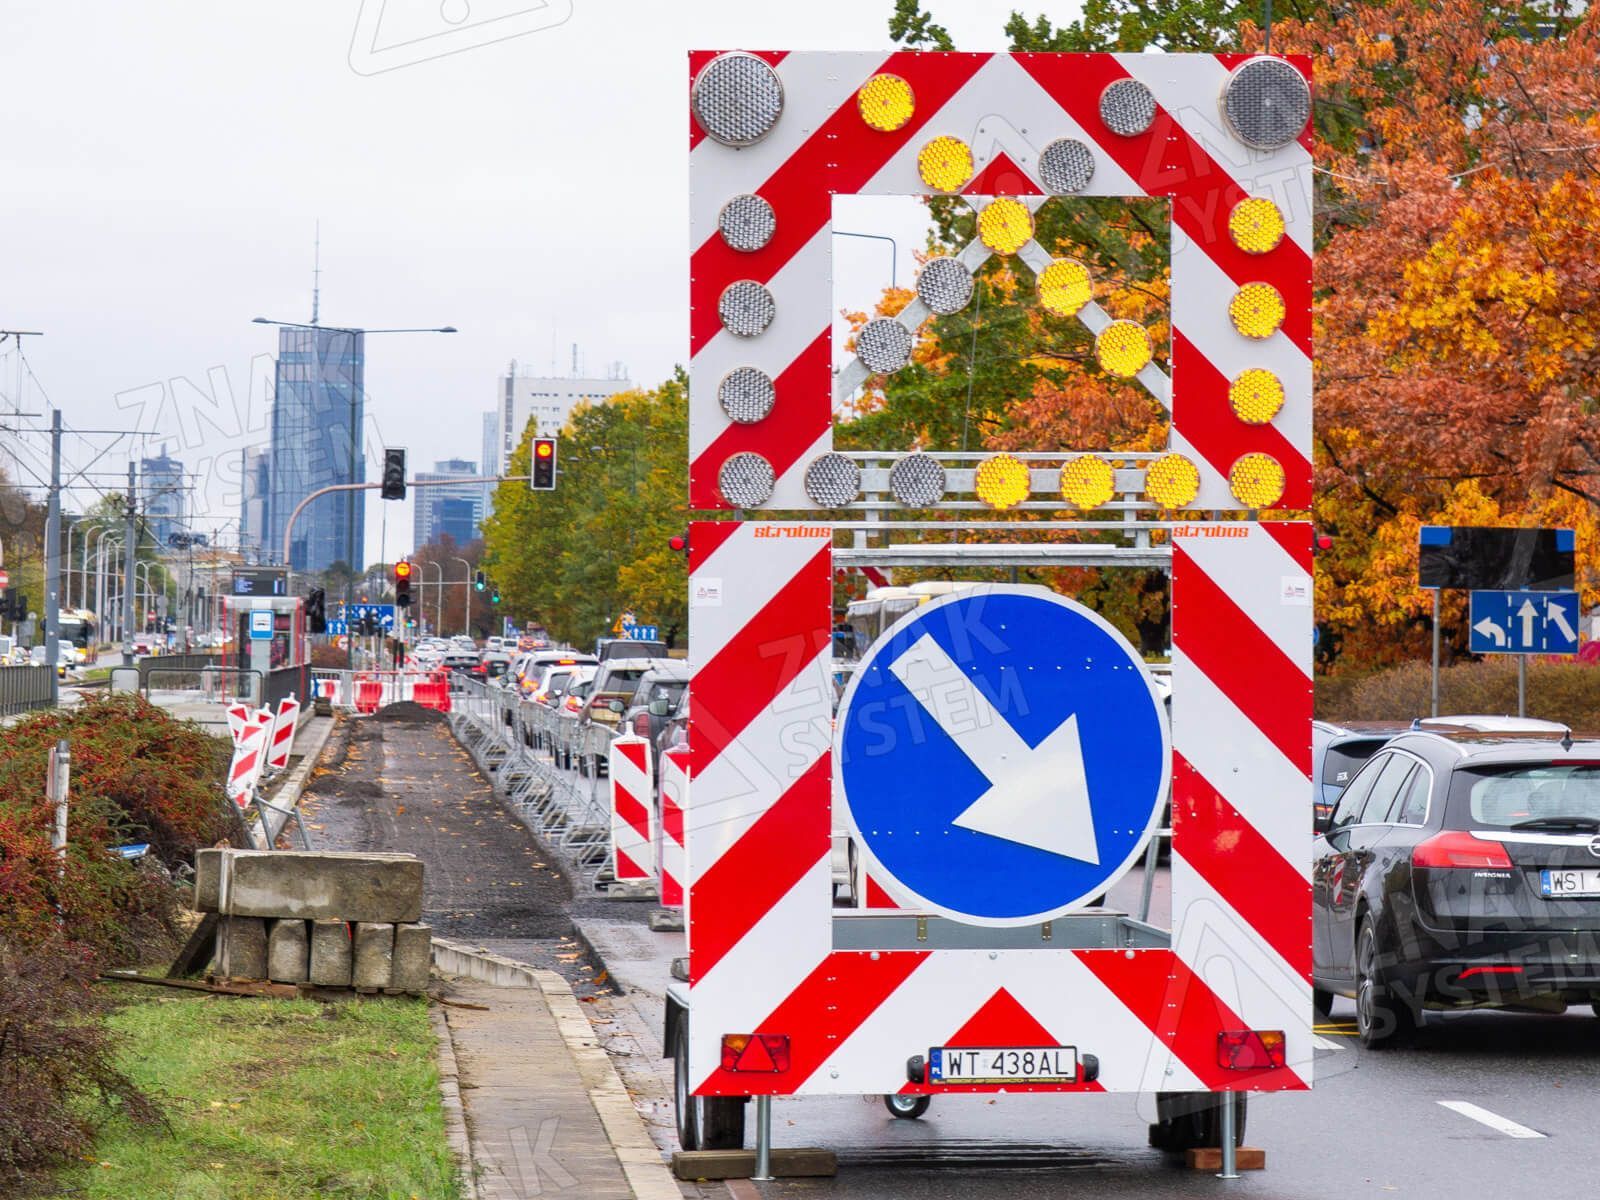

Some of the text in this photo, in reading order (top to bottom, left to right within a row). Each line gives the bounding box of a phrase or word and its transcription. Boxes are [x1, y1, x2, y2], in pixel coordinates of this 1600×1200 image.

[754, 525, 831, 537] strobos
[1174, 525, 1249, 537] strobos
[948, 1052, 1068, 1075] WT 438AL
